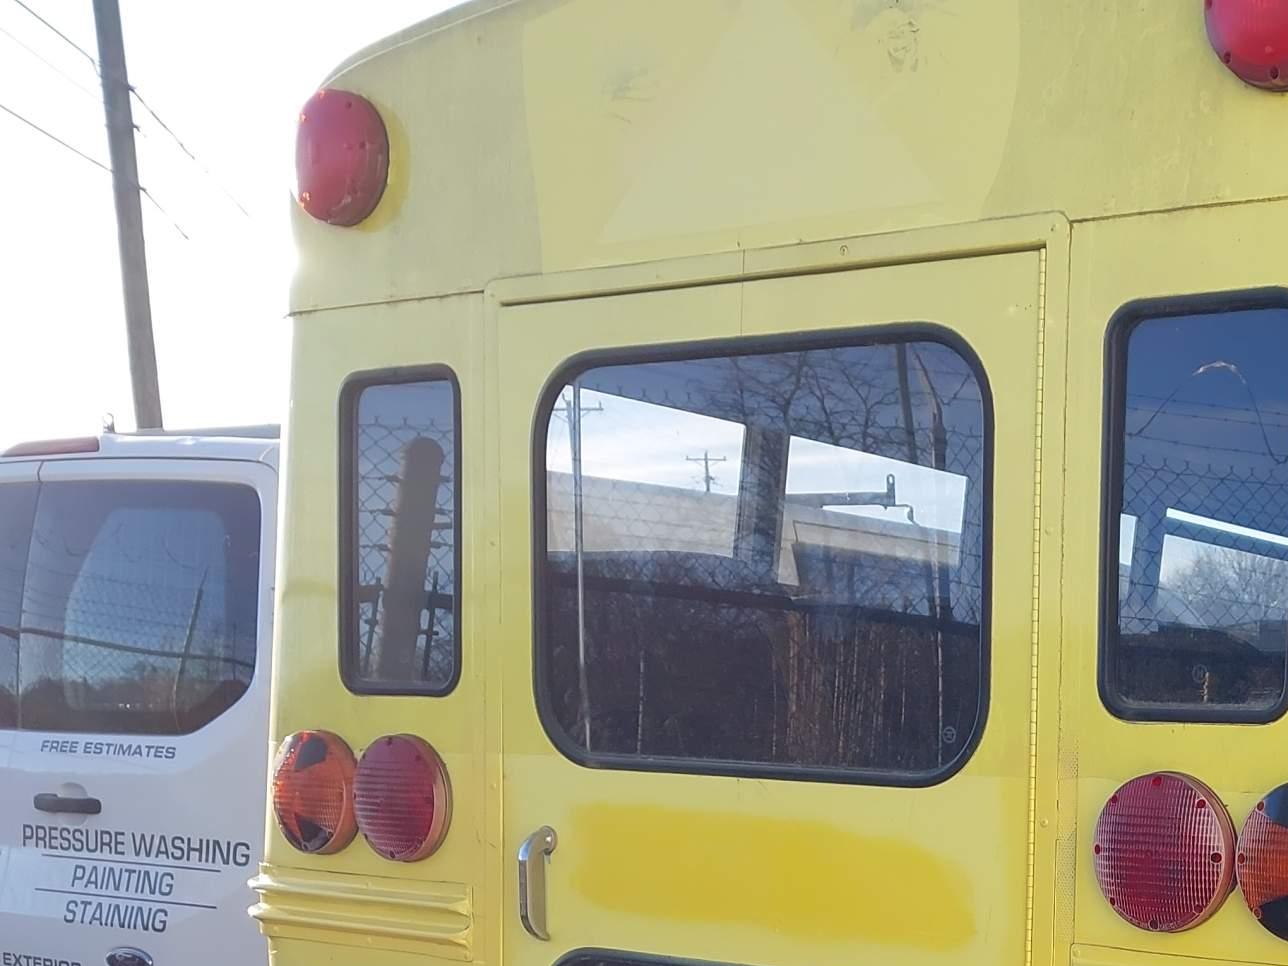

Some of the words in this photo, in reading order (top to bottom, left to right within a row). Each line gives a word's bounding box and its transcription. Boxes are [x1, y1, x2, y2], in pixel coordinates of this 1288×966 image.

[40, 739, 79, 754] FREE
[82, 741, 177, 760] ESTIMATES
[22, 823, 126, 856] PRESSURE
[131, 831, 251, 867] WASHING
[71, 864, 175, 897] PAINTING
[63, 899, 169, 933] STAINING
